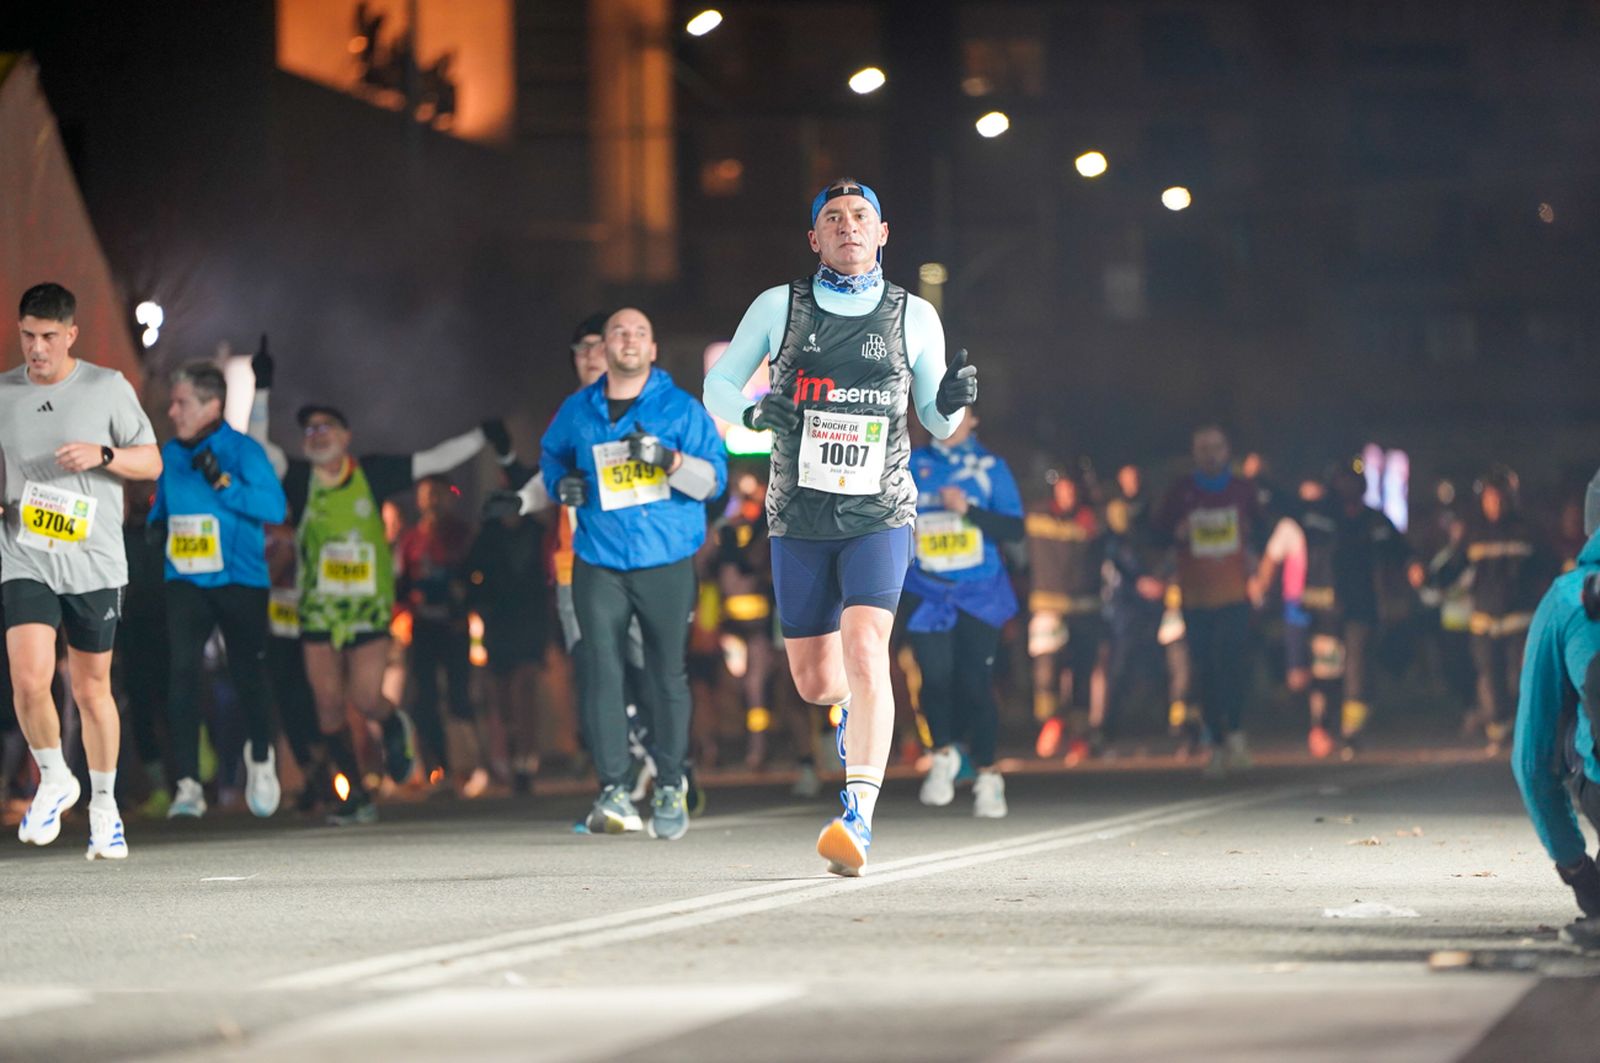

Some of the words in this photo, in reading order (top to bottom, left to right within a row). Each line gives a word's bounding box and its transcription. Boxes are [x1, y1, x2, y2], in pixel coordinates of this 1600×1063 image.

[811, 430, 828, 439] SAN
[821, 421, 848, 431] NOCHE
[849, 423, 859, 432] DE
[819, 442, 870, 467] 1007
[612, 463, 655, 484] 5249
[33, 509, 75, 535] 3704
